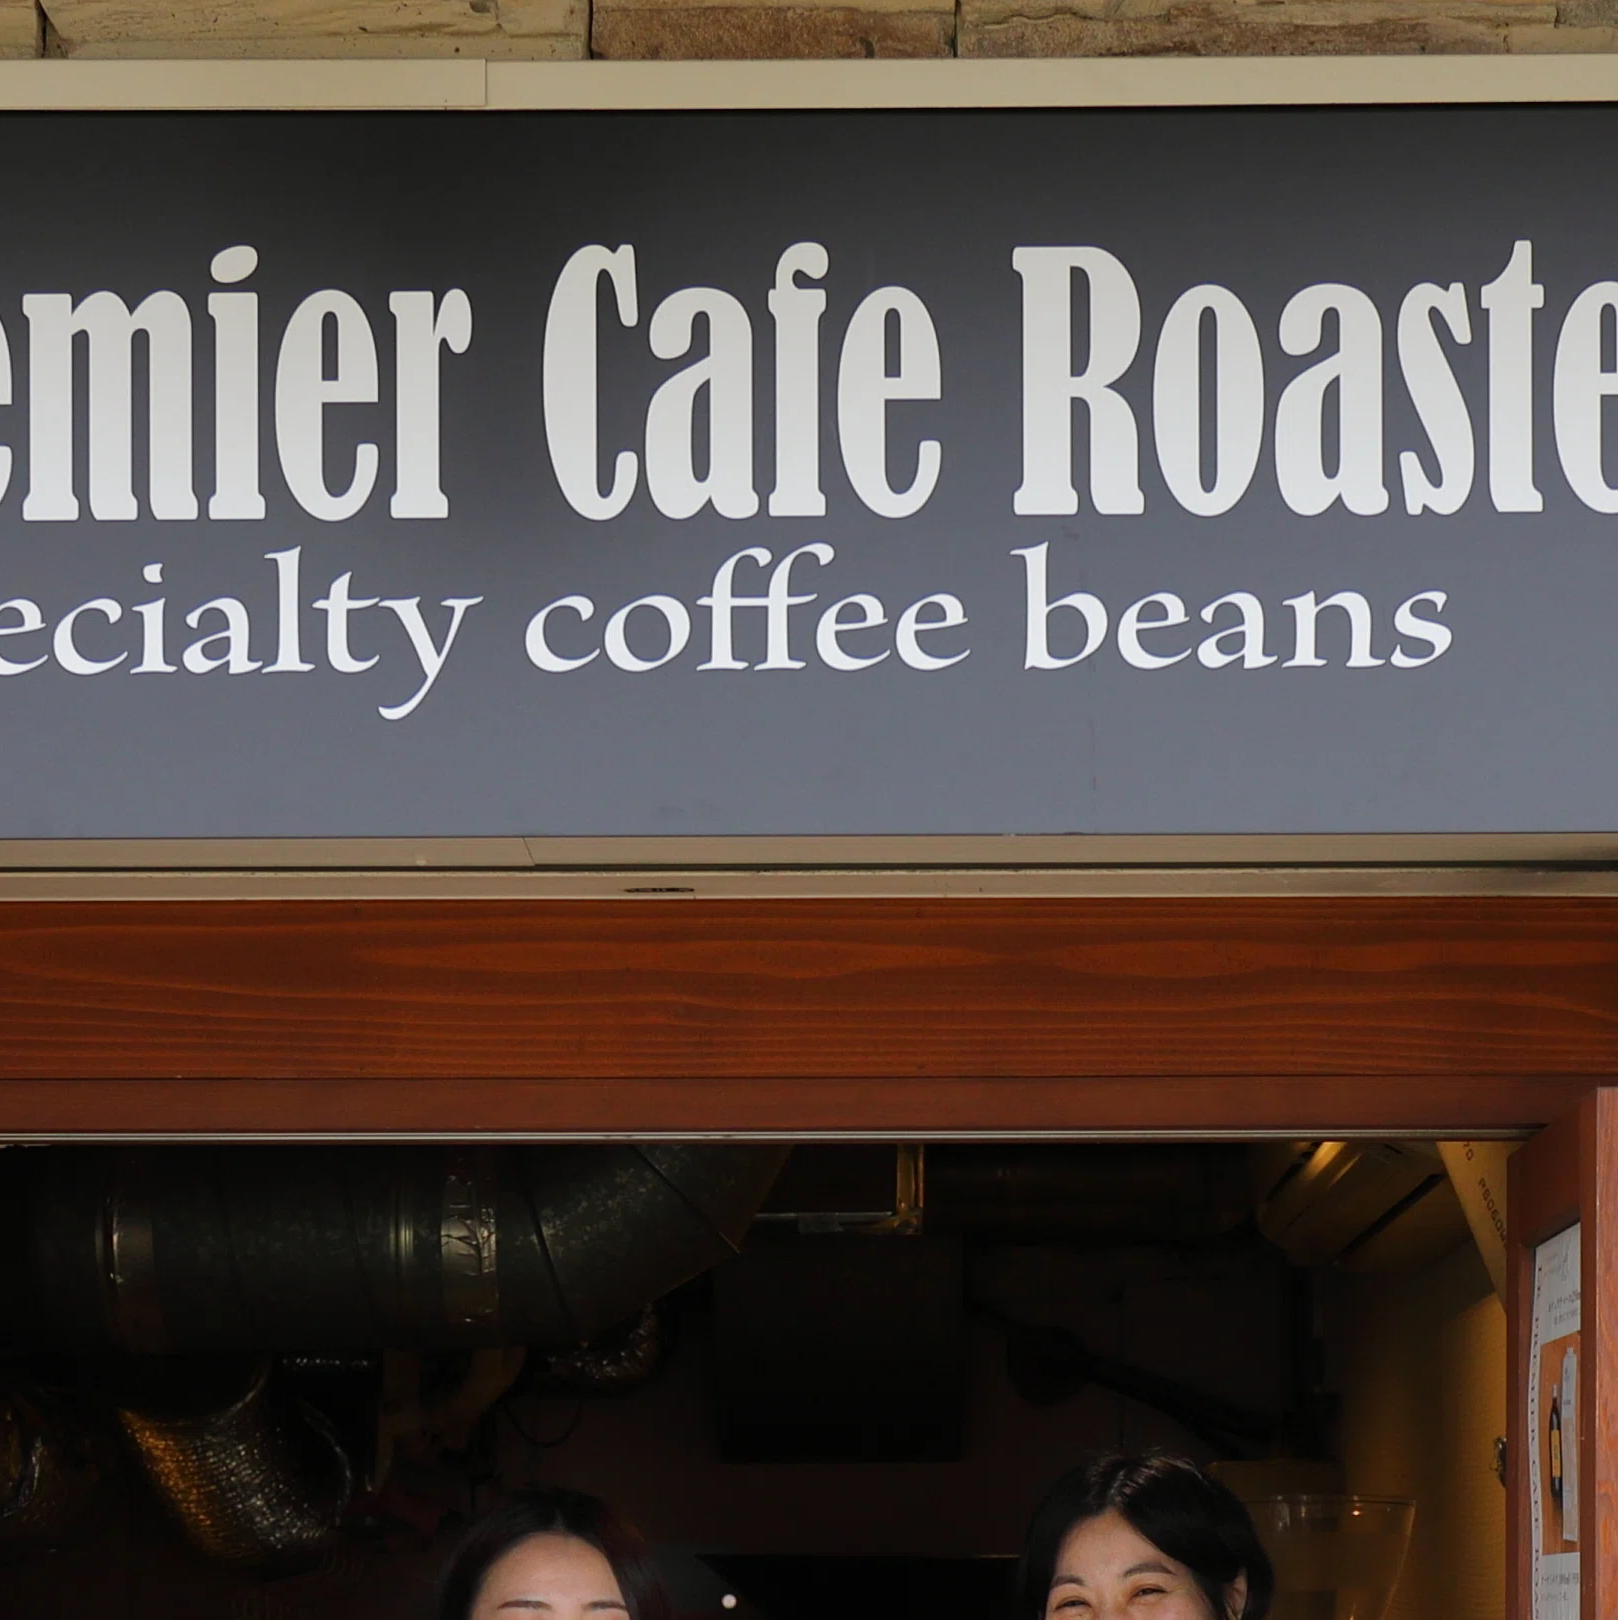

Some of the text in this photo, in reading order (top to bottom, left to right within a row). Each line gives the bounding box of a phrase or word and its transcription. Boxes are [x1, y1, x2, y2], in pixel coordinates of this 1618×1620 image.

[542, 241, 942, 521] Cafe
[525, 542, 971, 672] coffee
[1024, 541, 1455, 671] beans
